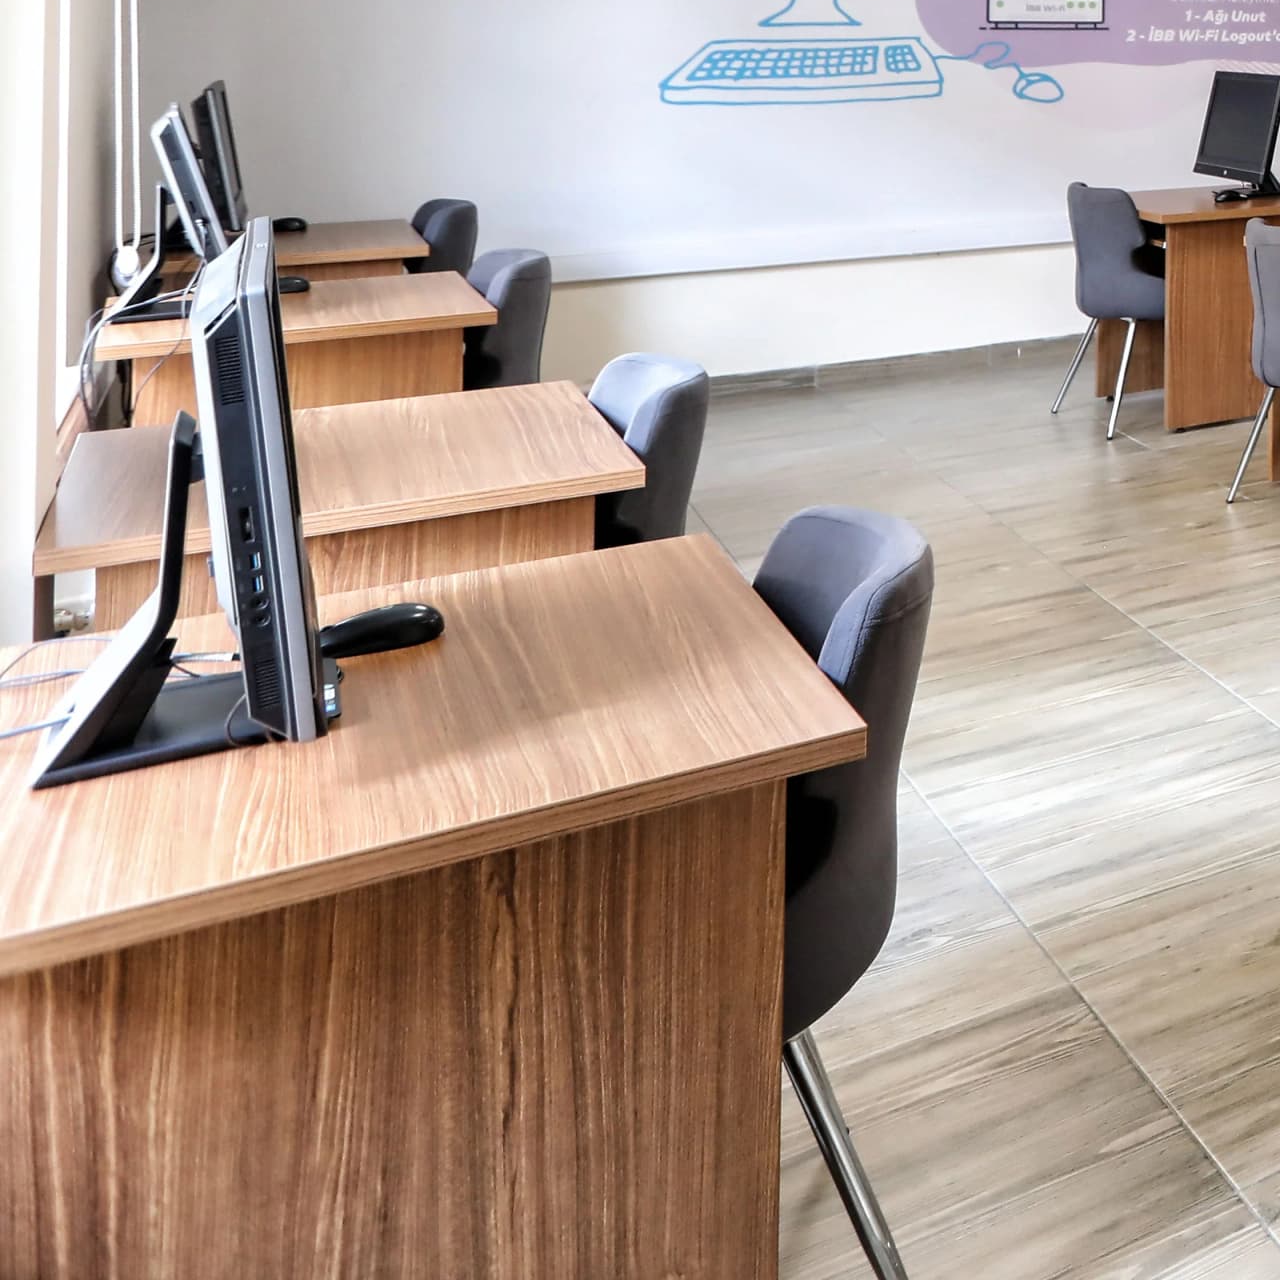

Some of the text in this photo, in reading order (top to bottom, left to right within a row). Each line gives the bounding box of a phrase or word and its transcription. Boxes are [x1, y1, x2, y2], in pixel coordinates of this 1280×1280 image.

[1203, 9, 1229, 25] Ağı
[1231, 10, 1266, 23] Unut
[1148, 25, 1175, 42] İBB
[1179, 29, 1220, 42] Wi-Fi
